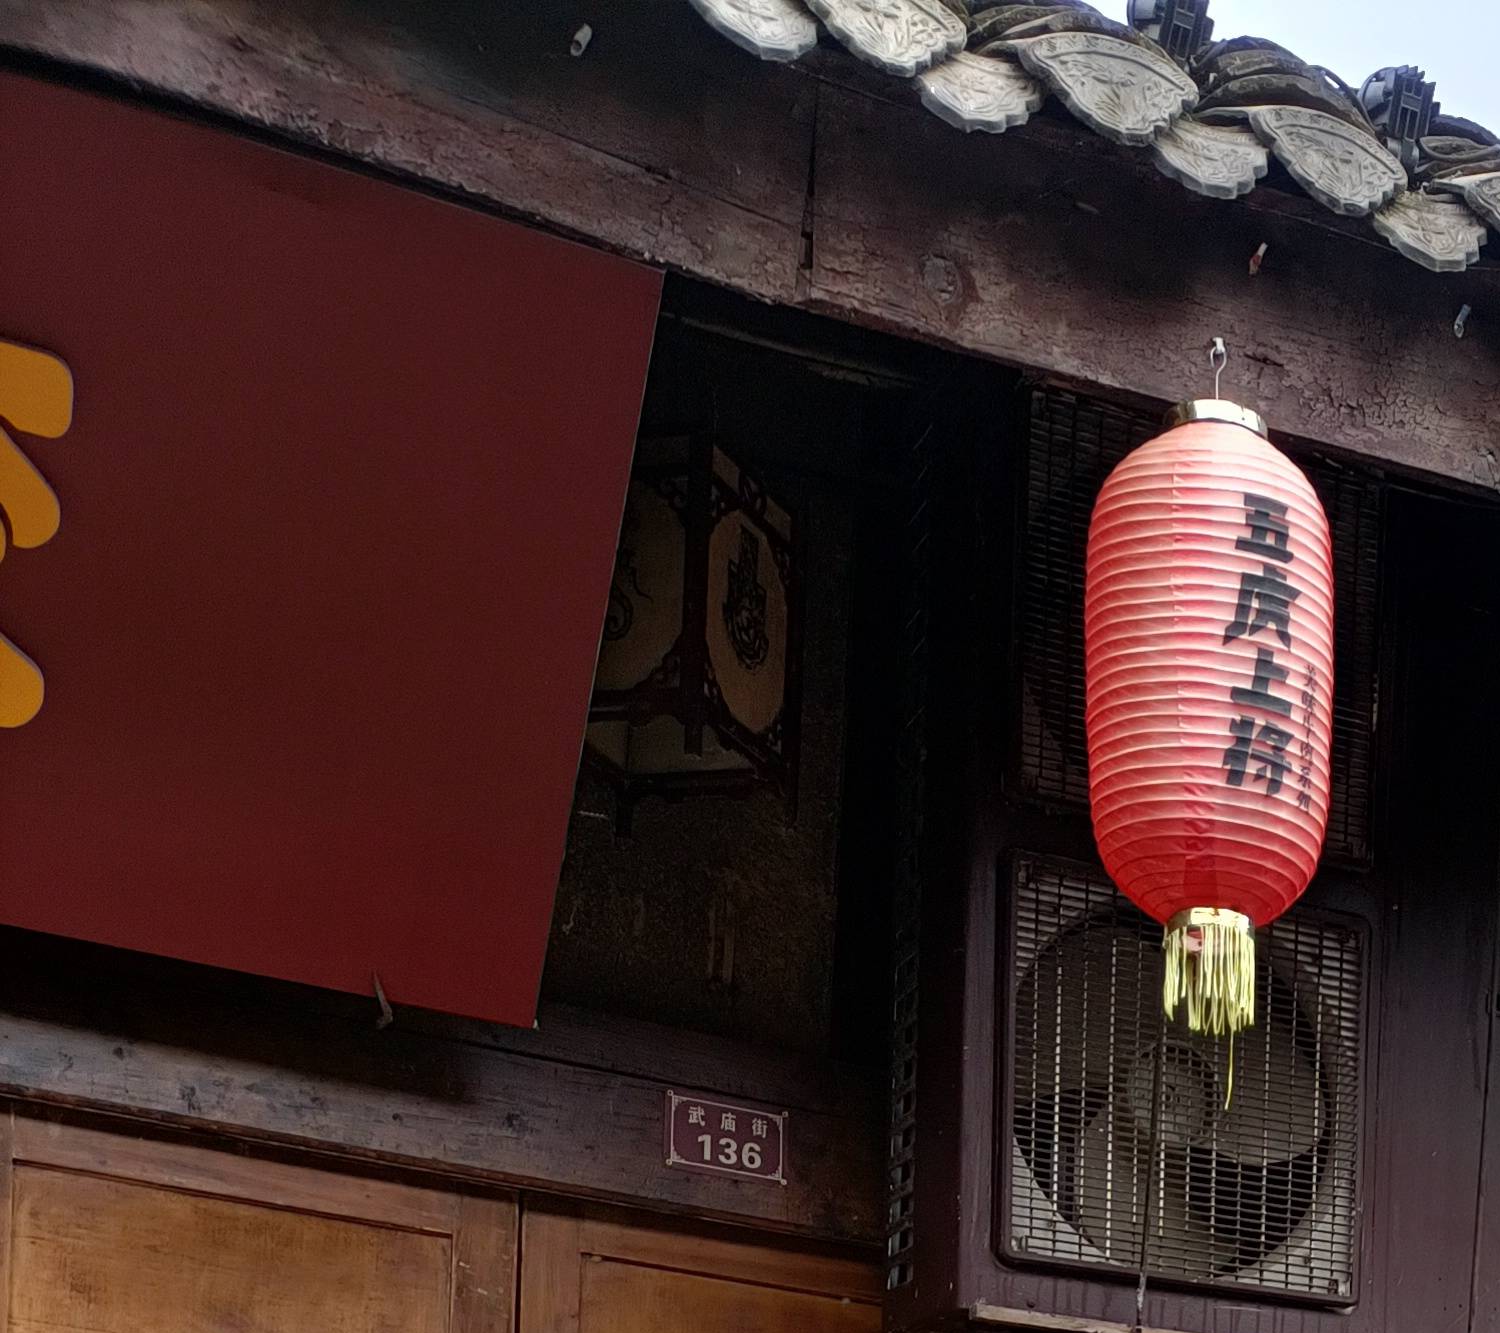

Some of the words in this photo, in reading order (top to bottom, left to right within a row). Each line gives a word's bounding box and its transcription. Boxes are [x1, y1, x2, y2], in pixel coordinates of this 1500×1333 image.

[1222, 492, 1302, 799] 五虎上将
[688, 1105, 769, 1139] 武庙街
[697, 1133, 763, 1170] 136
